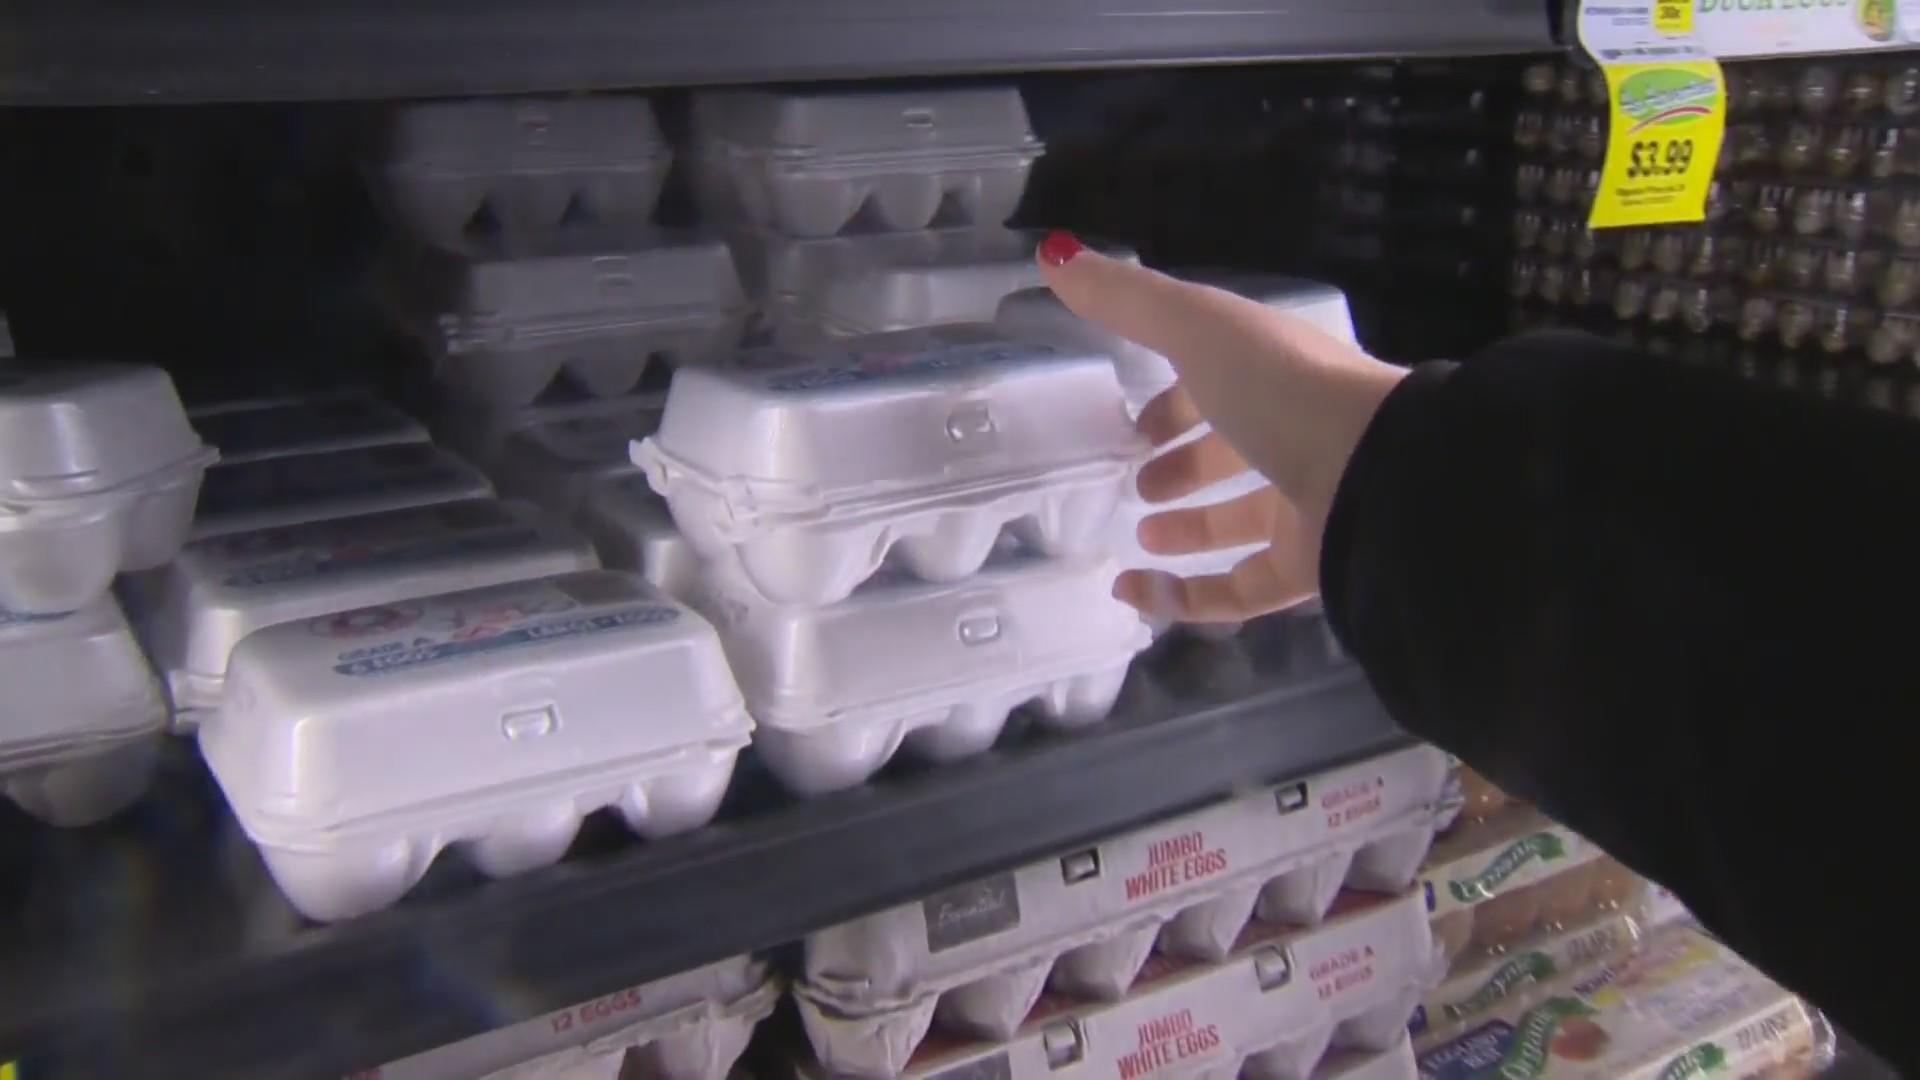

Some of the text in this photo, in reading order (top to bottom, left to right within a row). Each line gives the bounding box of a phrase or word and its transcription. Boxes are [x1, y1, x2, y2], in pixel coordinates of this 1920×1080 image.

[1627, 139, 1693, 178] $3.99
[1328, 812, 1341, 828] 12
[1147, 831, 1203, 867] JUMBO
[1124, 848, 1227, 901] WHITE EGGS
[1310, 950, 1359, 981] GRADE
[551, 990, 641, 1034] 12 EGGS
[1138, 1008, 1194, 1047] JUMBO
[1117, 1024, 1220, 1080] WHITE EGGS
